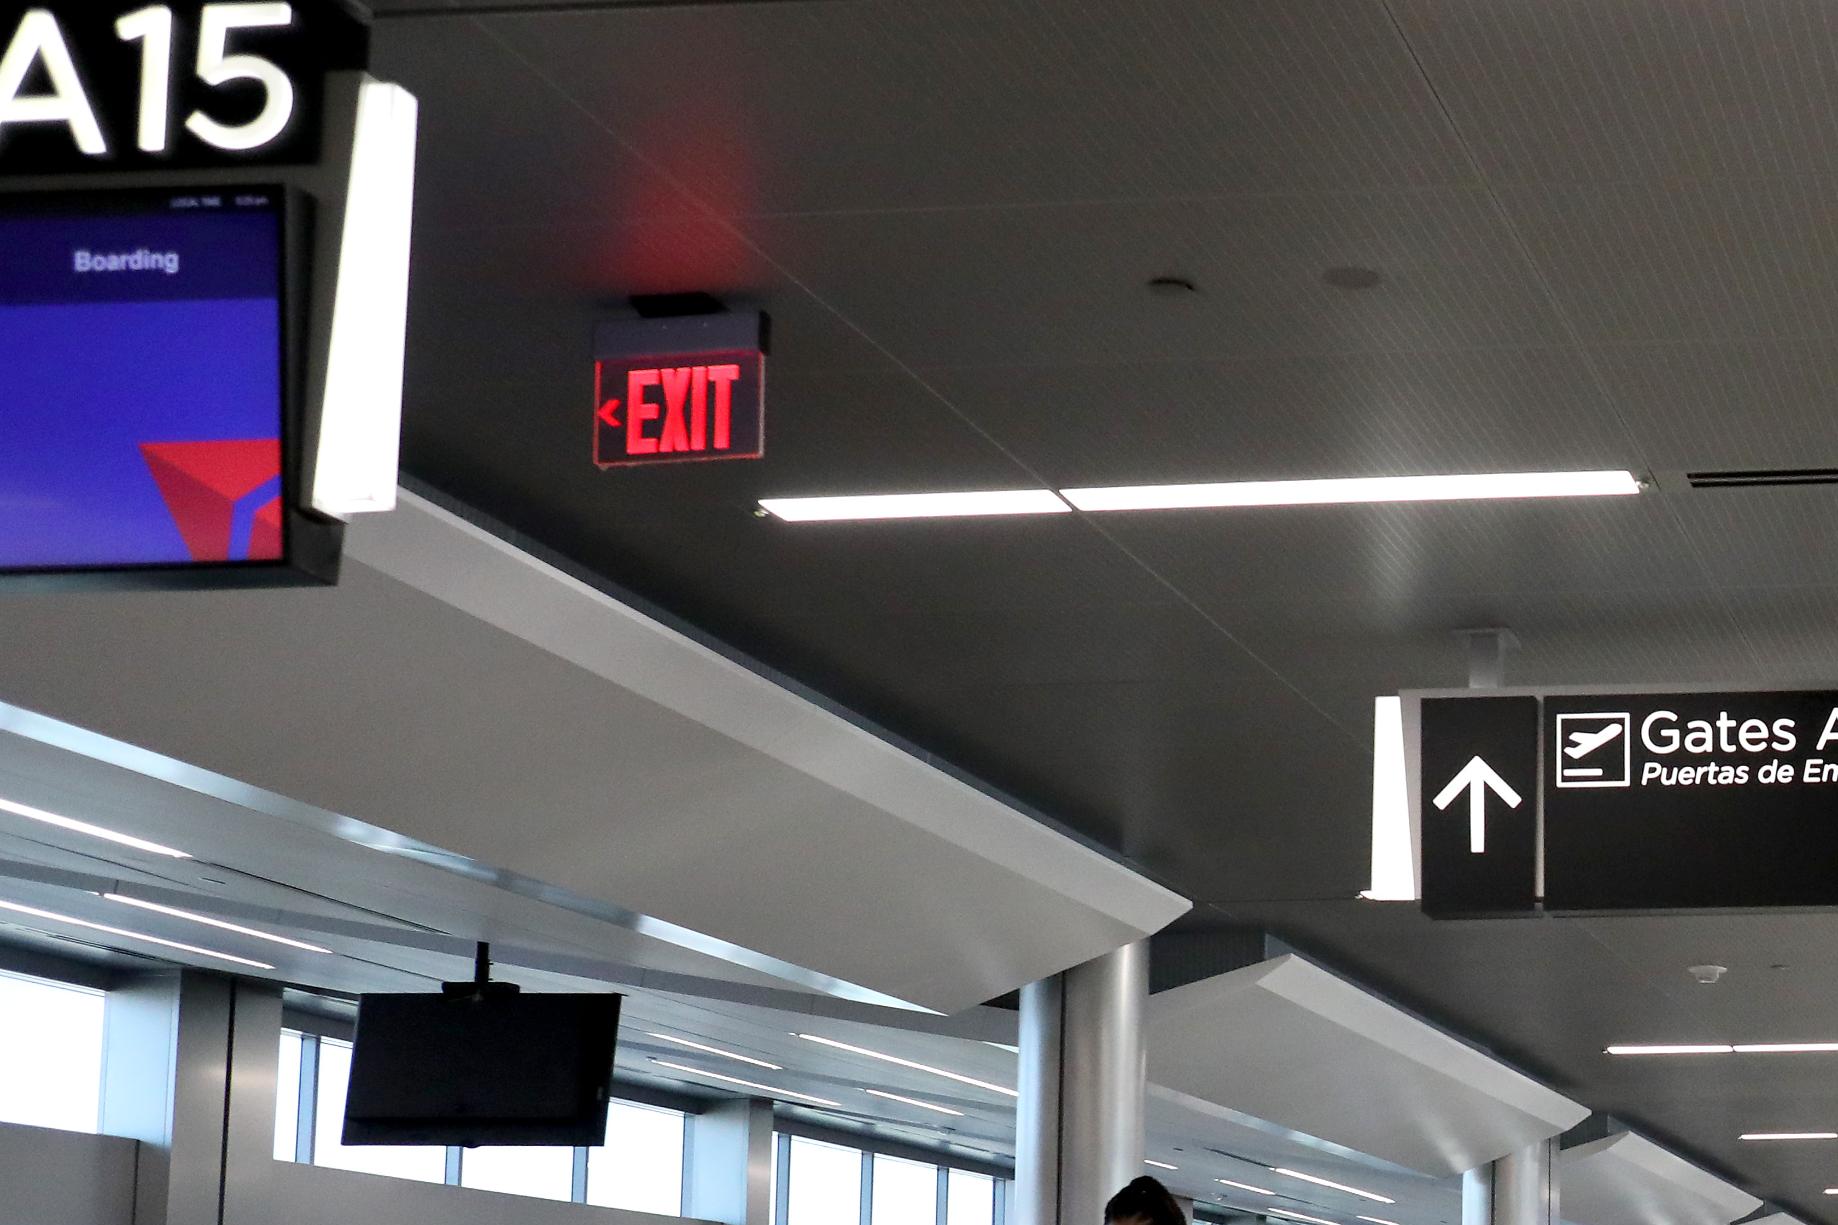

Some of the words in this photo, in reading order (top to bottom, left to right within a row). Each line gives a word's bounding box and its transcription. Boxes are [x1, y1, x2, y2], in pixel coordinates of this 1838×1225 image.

[0, 2, 294, 154] A15
[74, 249, 179, 275] Boarding
[626, 364, 740, 455] EXIT
[1640, 710, 1797, 754] Gates
[1641, 761, 1752, 786] Puertas
[1758, 759, 1794, 784] de
